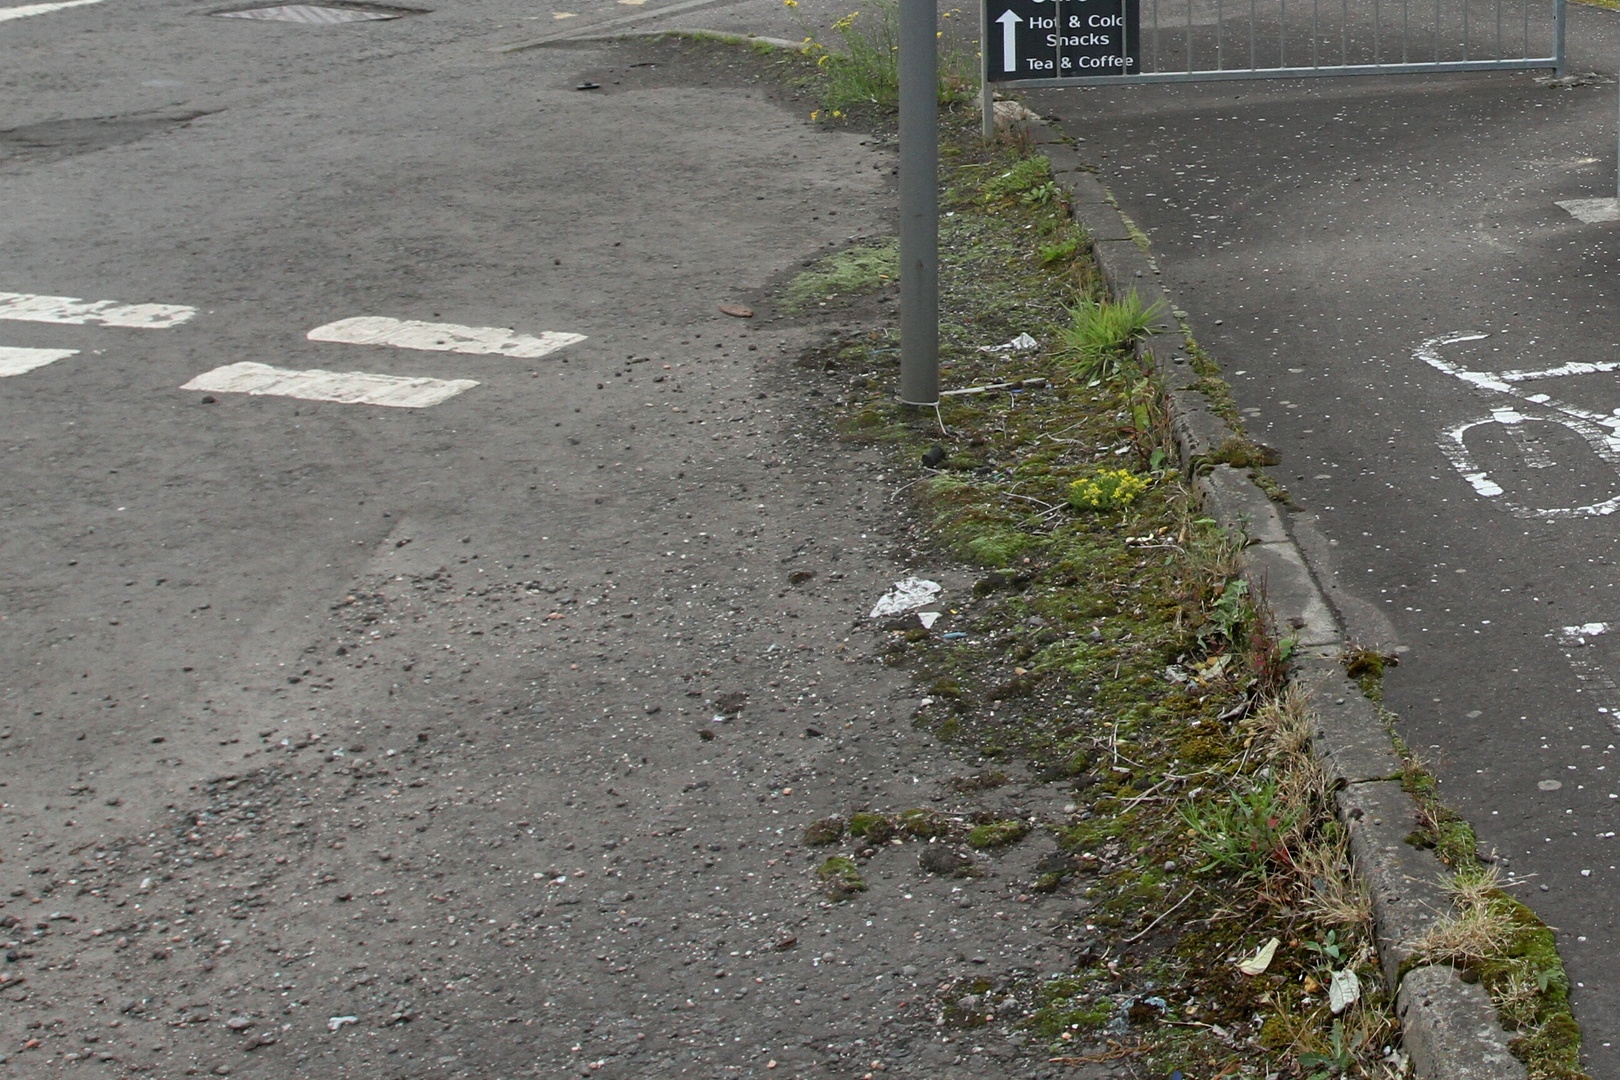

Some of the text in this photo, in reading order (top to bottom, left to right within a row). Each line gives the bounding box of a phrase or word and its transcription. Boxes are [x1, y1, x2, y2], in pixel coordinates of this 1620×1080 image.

[1068, 15, 1081, 28] &
[1046, 32, 1110, 47] Snacks
[1026, 55, 1134, 70] Tea & Coffee
